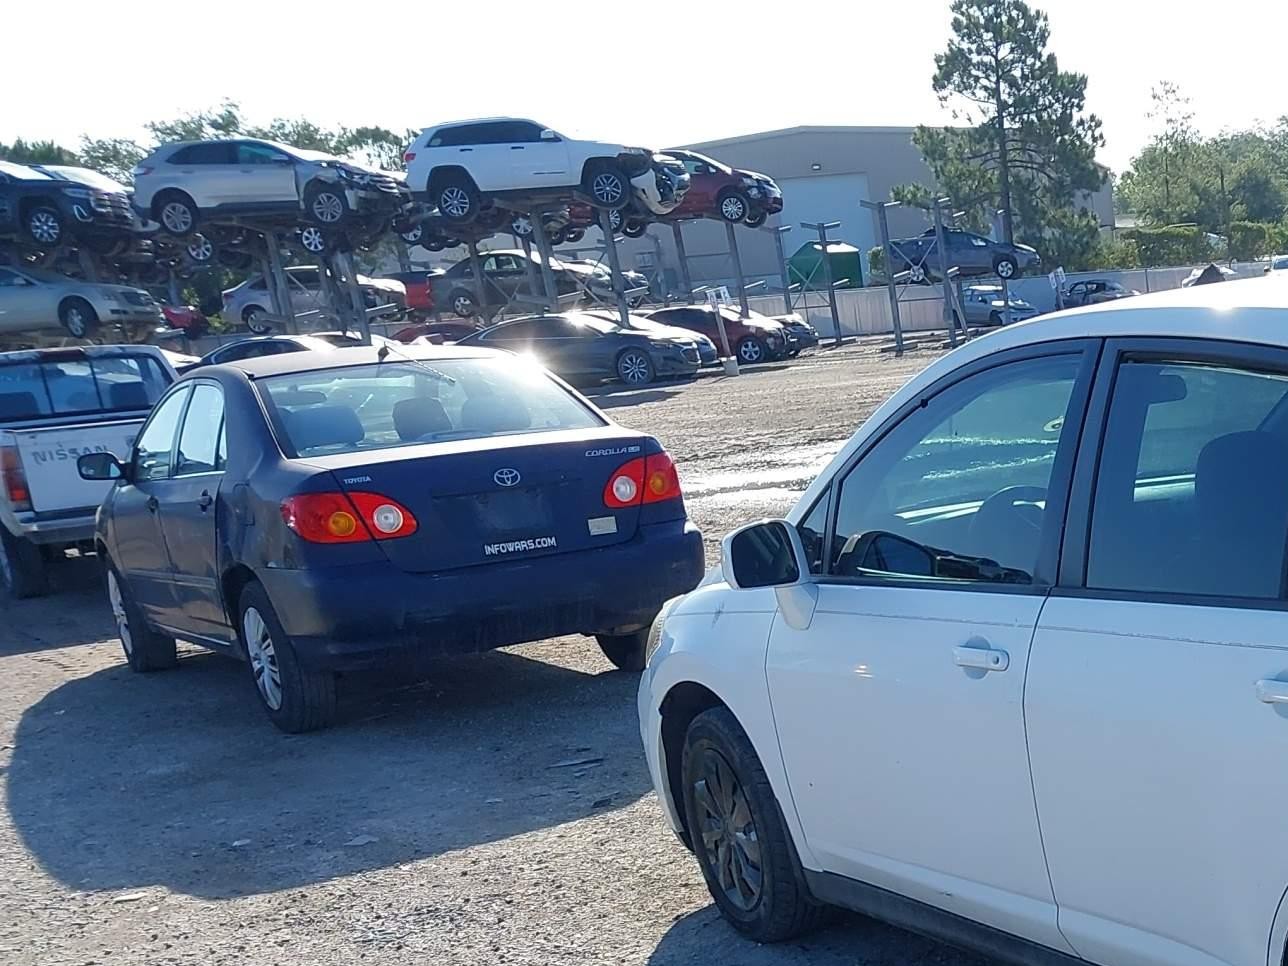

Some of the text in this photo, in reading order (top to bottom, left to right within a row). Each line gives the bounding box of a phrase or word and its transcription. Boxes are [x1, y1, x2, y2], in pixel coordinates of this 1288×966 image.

[32, 445, 108, 464] NISSAN
[585, 447, 627, 457] COROLLA
[343, 475, 372, 484] TOYOTA
[484, 536, 557, 555] INFOWARS.COM
